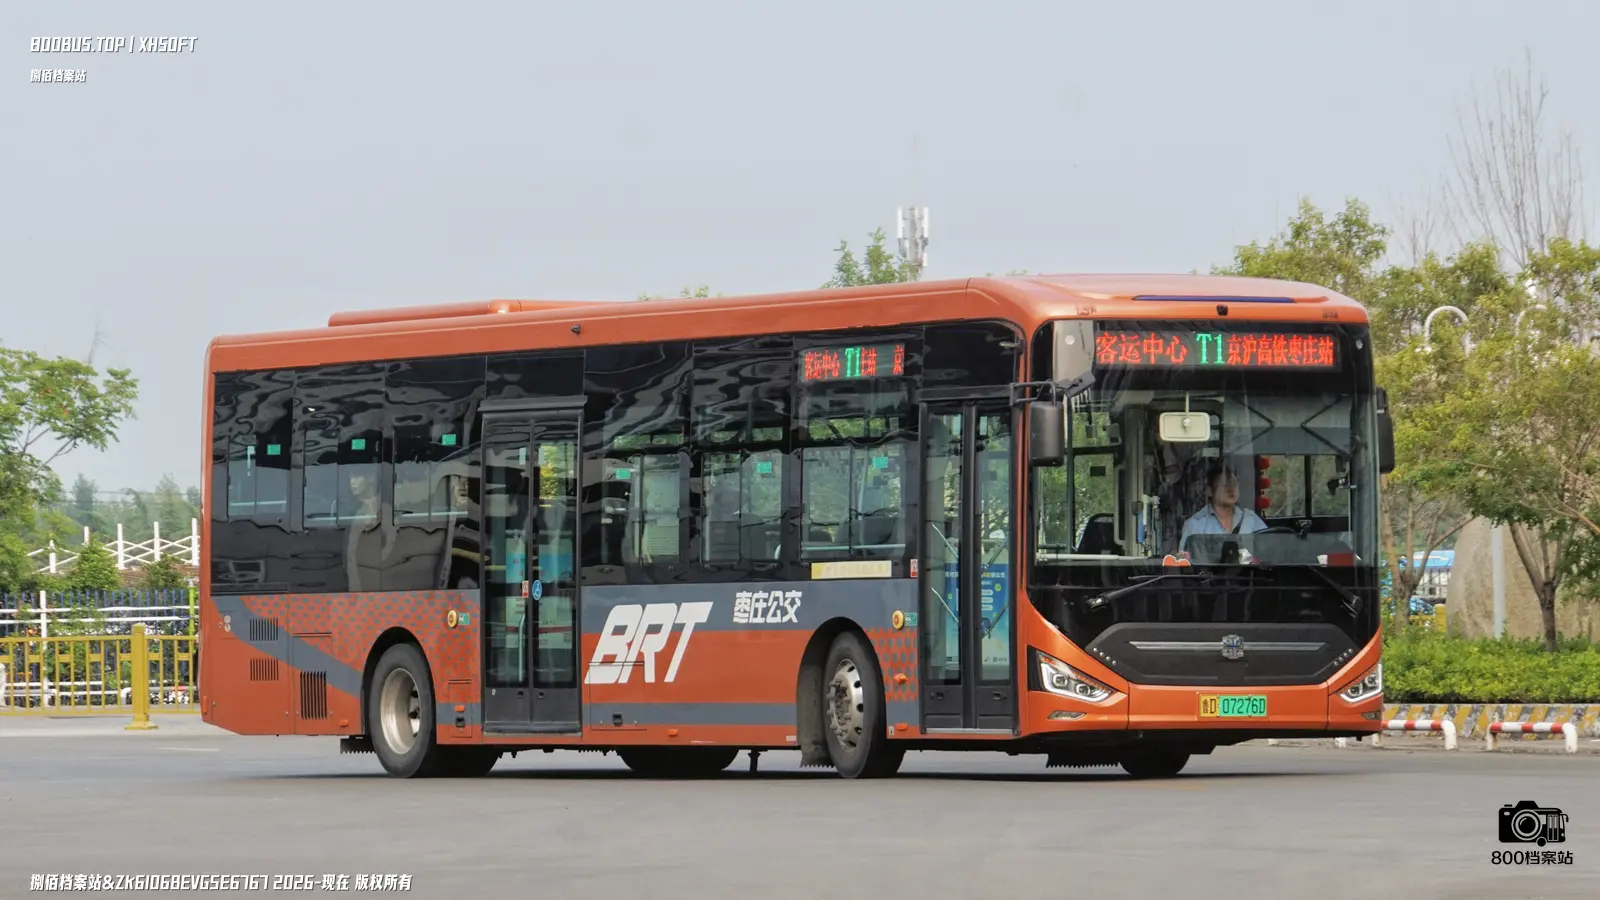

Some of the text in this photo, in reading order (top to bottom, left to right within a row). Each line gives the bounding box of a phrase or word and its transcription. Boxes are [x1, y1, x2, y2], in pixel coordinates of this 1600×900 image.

[845, 347, 861, 377] T1
[1096, 332, 1335, 366] 客运中心 T1 京沪高铁枣庄站
[733, 590, 802, 623] 枣庄公交
[584, 601, 714, 684] BRT
